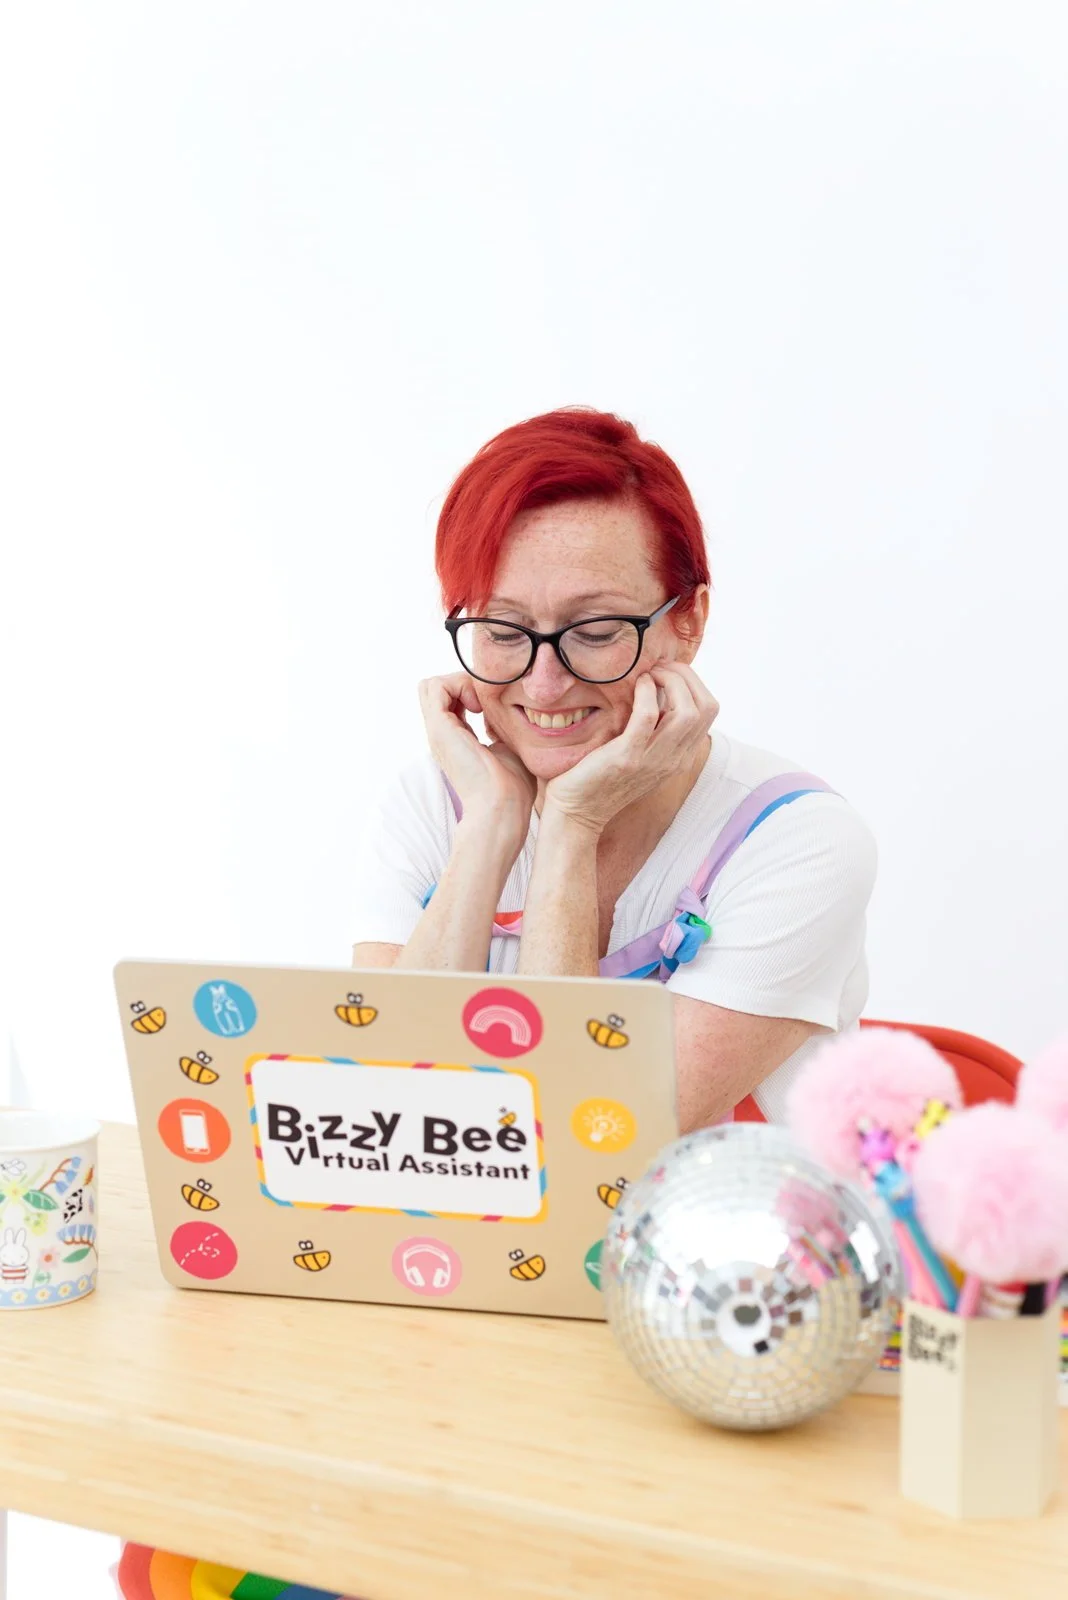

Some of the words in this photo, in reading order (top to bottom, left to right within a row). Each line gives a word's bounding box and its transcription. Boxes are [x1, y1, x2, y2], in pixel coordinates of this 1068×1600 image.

[267, 1103, 401, 1158] Bizzy
[423, 1116, 527, 1156] Bee
[284, 1124, 389, 1172] Virtual
[398, 1154, 530, 1180] Assistant
